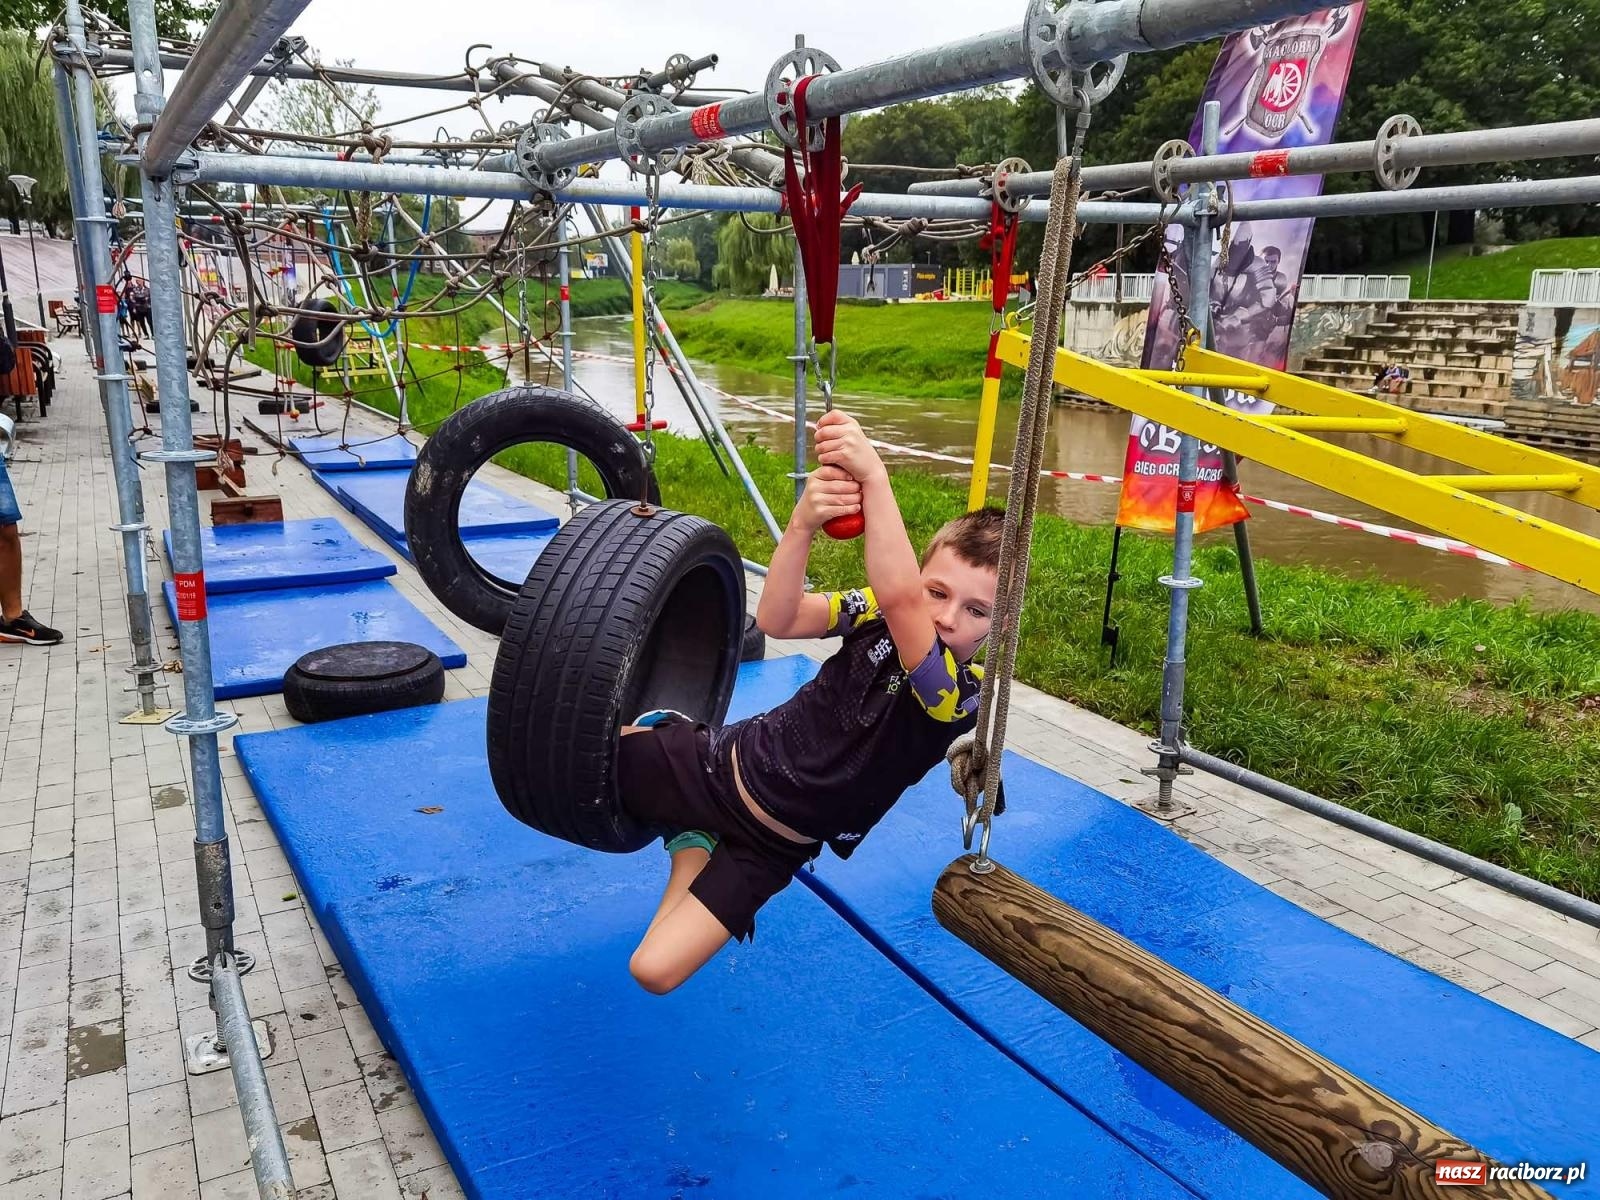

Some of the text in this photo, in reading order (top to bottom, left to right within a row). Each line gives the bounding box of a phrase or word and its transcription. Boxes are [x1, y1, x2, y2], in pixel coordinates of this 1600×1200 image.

[1264, 113, 1286, 127] OCR
[1134, 461, 1156, 475] BIEG
[1158, 463, 1180, 476] OCR
